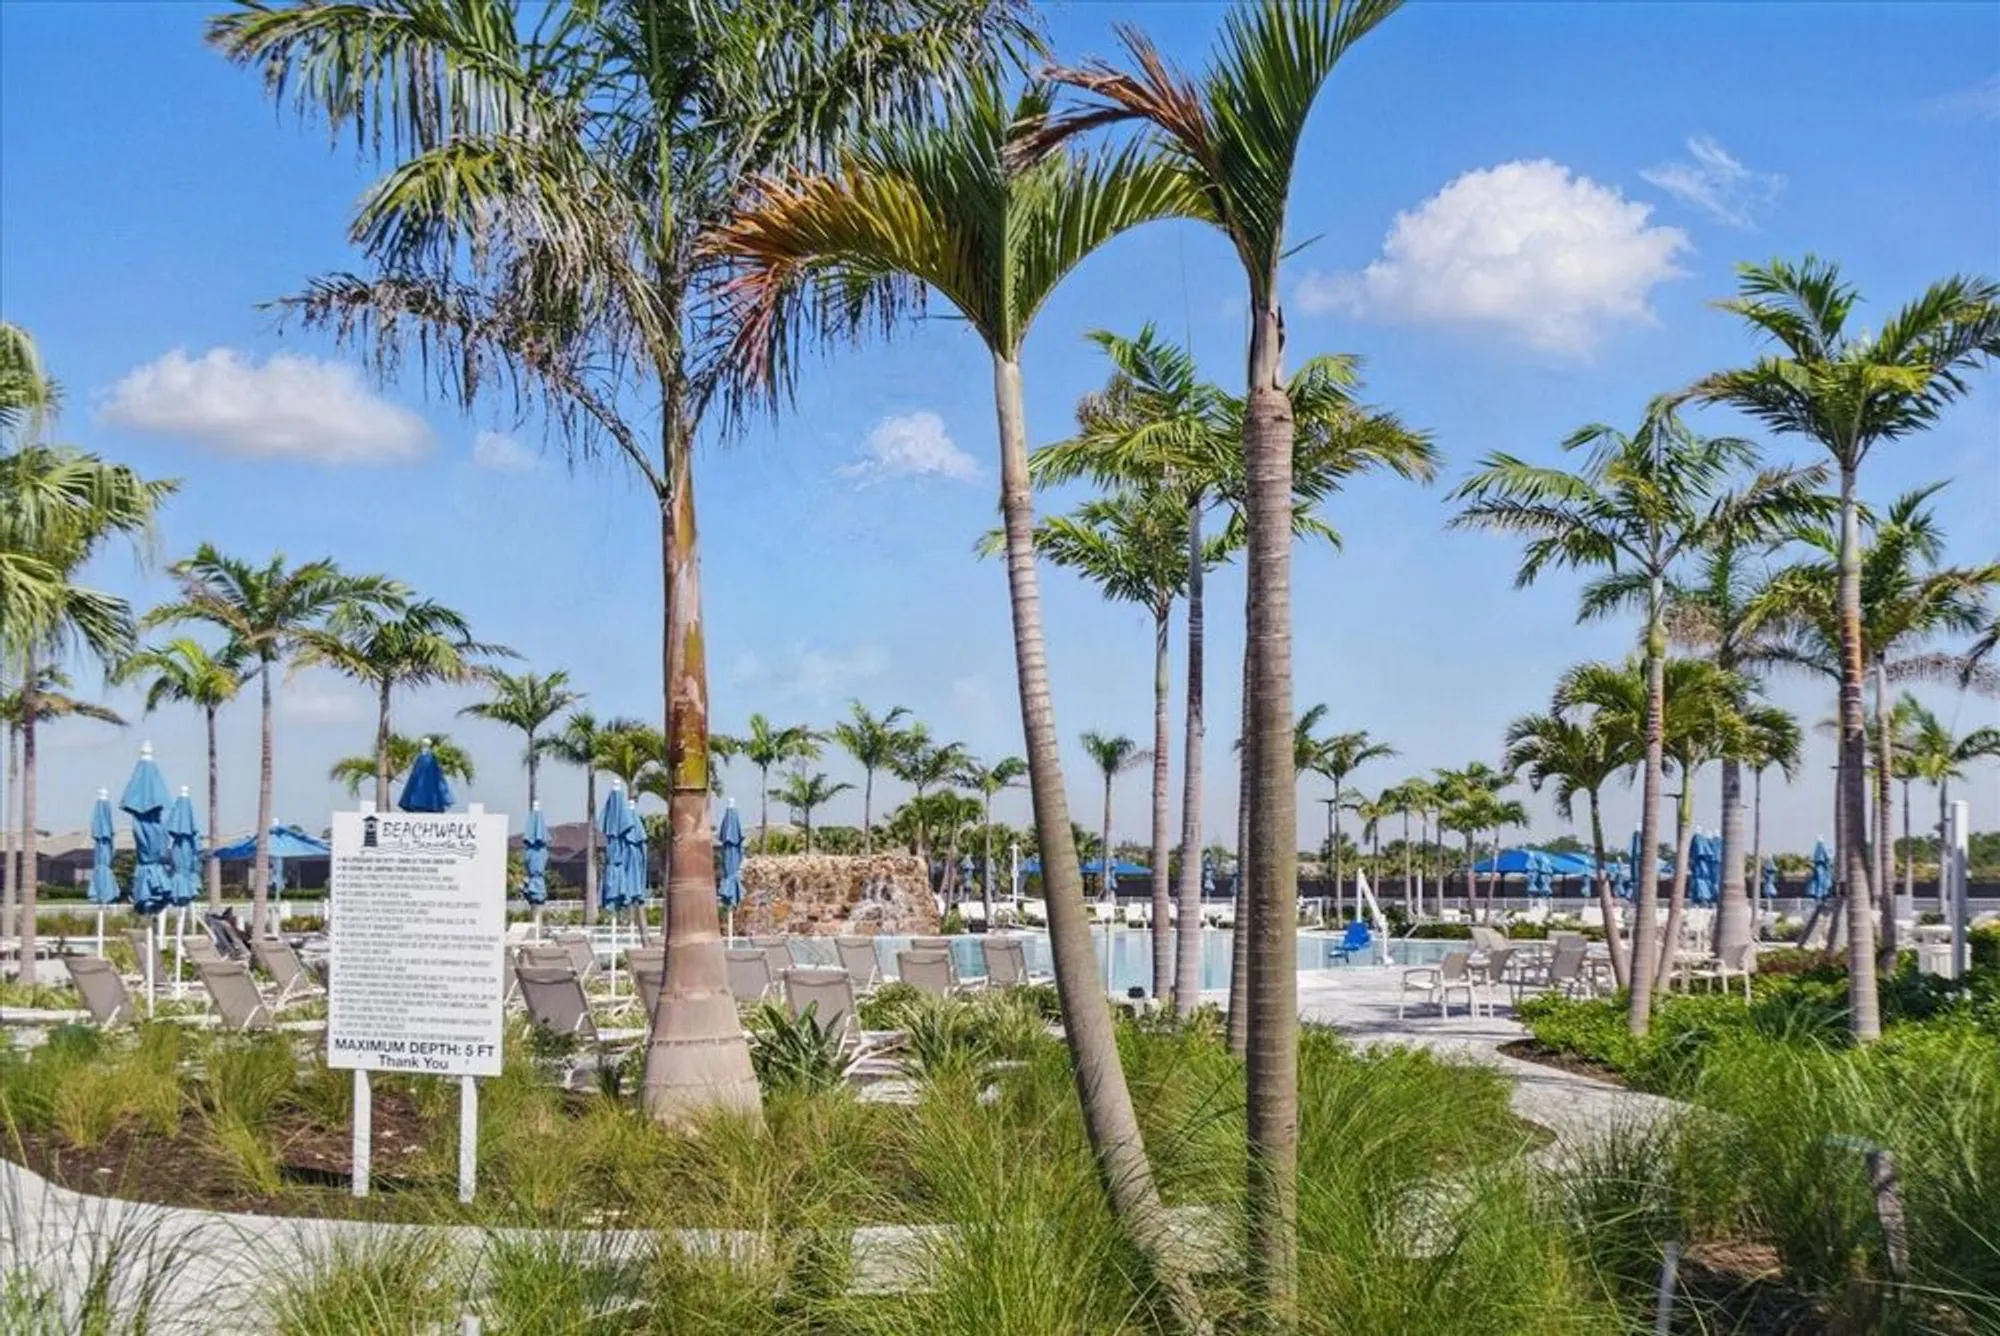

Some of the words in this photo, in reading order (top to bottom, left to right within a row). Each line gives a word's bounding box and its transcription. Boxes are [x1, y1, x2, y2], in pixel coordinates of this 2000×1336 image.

[382, 821, 477, 839] BEACHWALK
[334, 1038, 405, 1053] MAXIMUM
[409, 1041, 462, 1056] DEPTH:
[465, 1044, 474, 1057] 5
[477, 1045, 496, 1058] FT
[378, 1054, 419, 1068] Thank
[424, 1056, 449, 1070] You
